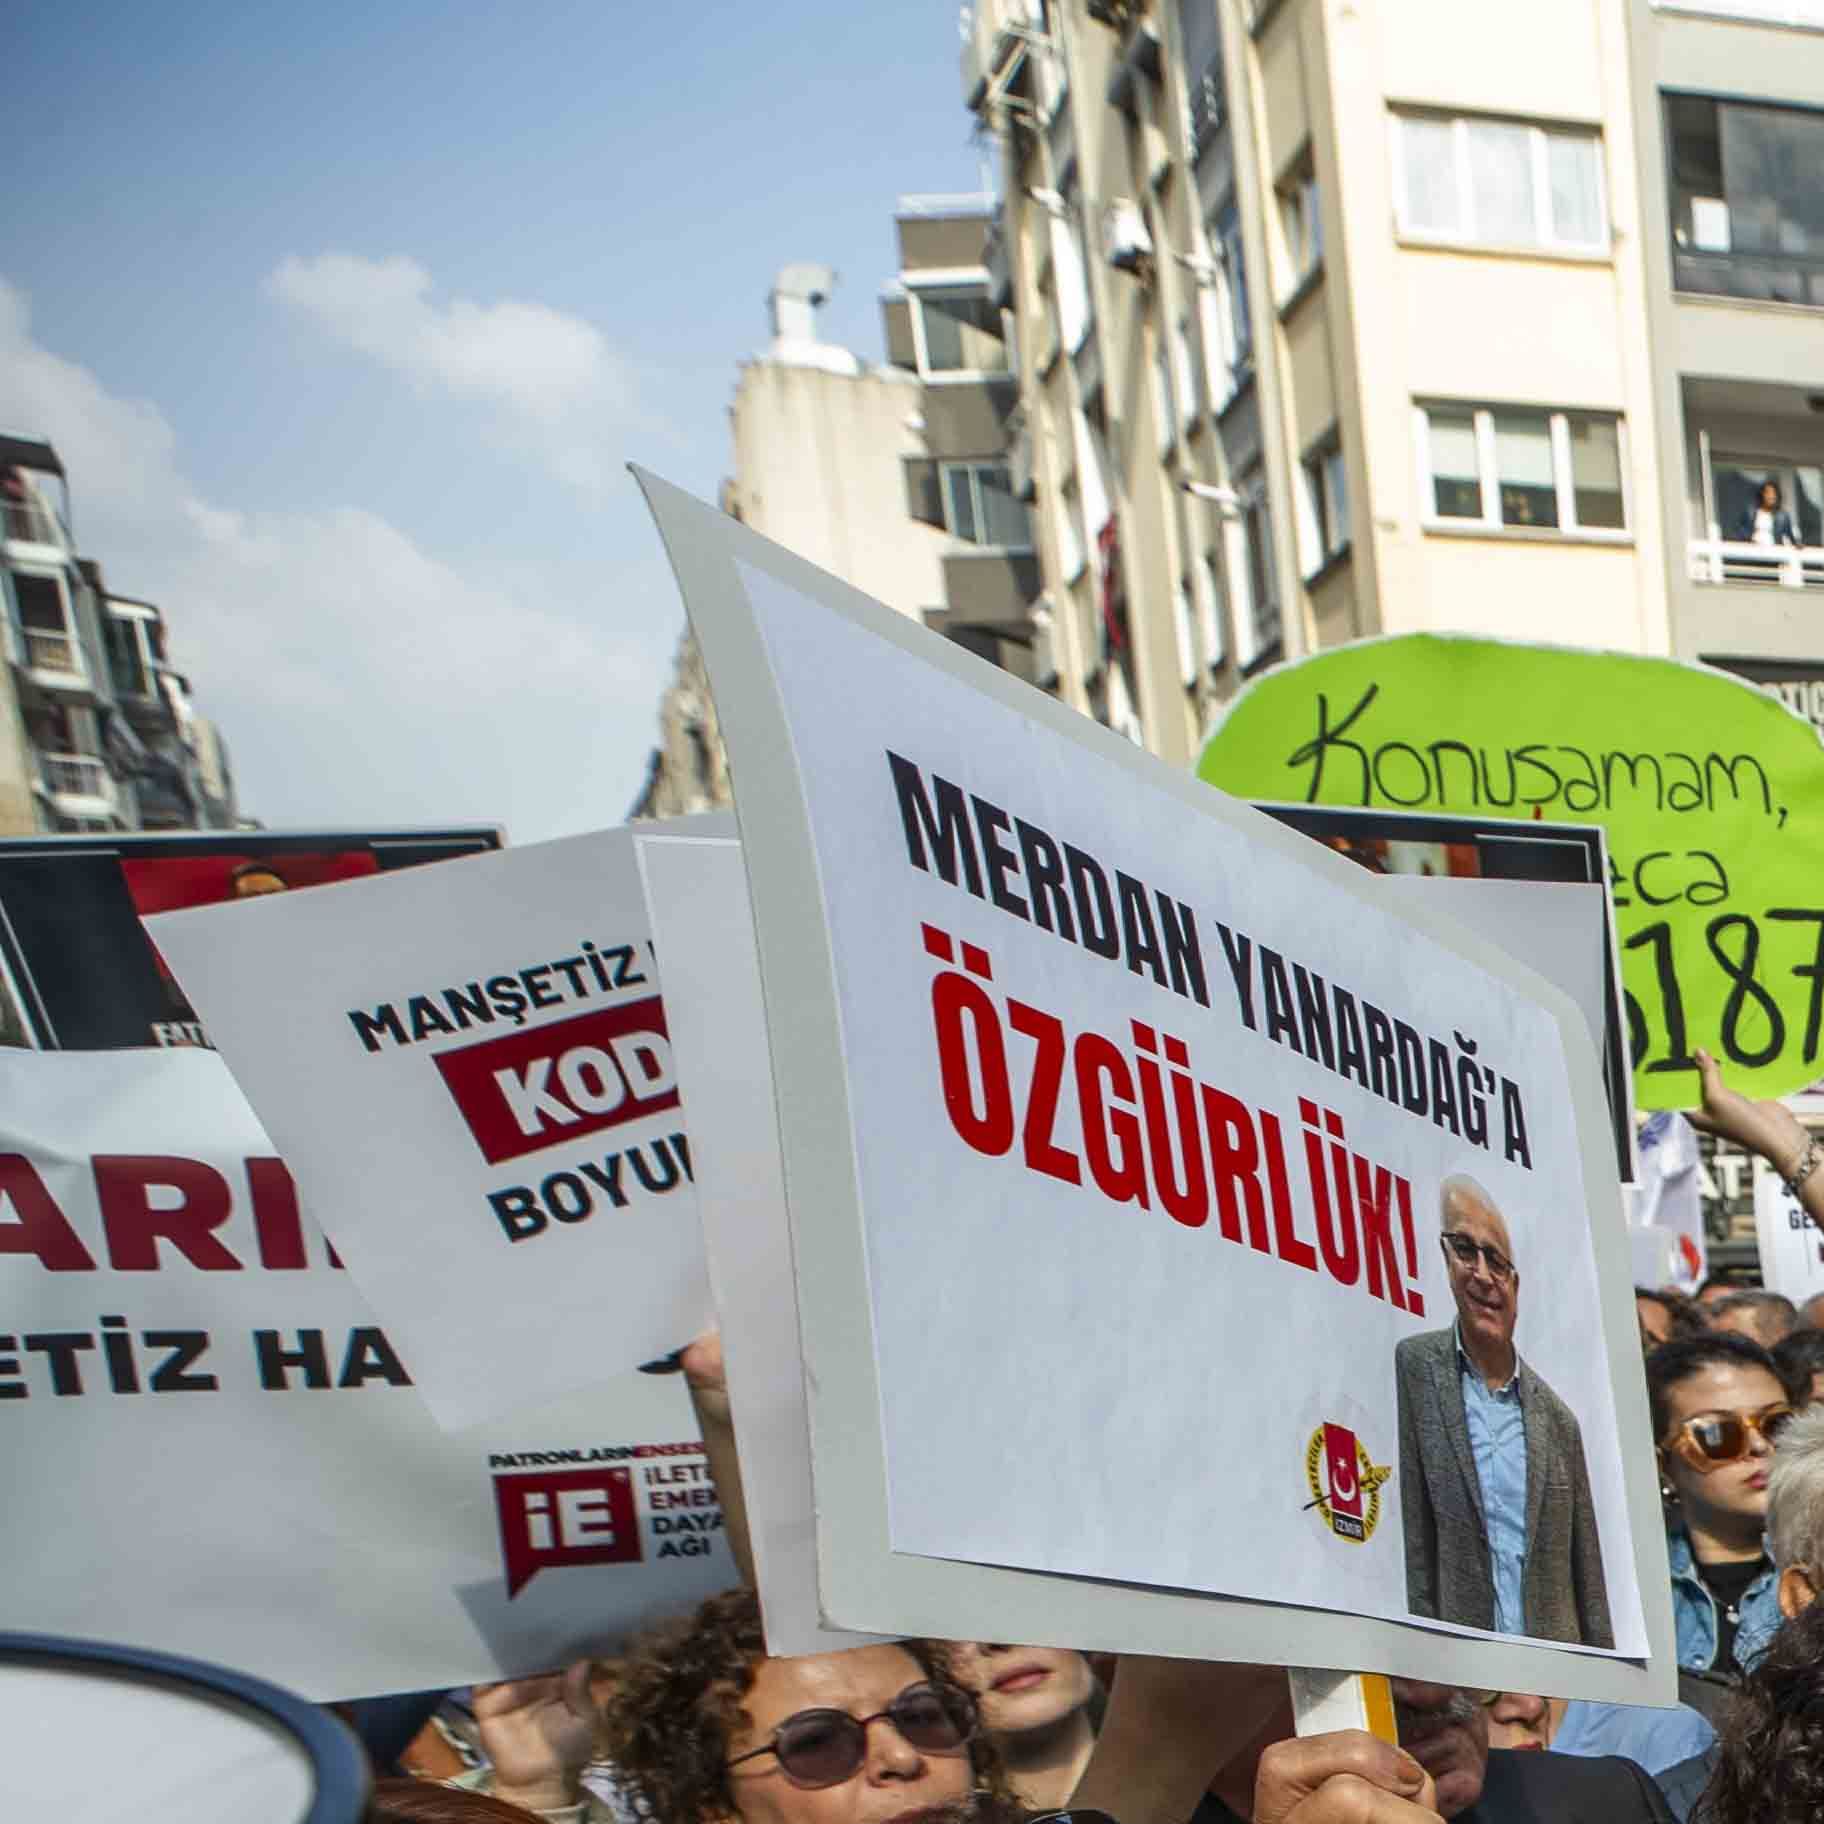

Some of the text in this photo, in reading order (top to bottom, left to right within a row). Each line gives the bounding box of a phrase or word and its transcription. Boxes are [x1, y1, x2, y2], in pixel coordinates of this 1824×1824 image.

[347, 941, 647, 1052] MANŞETİZ
[887, 750, 1533, 1169] MERDAN YANARDAĞ'A
[493, 1031, 678, 1136] KOD
[920, 922, 1426, 1318] ÖZGÜRLÜK!
[0, 1153, 344, 1271] ARI
